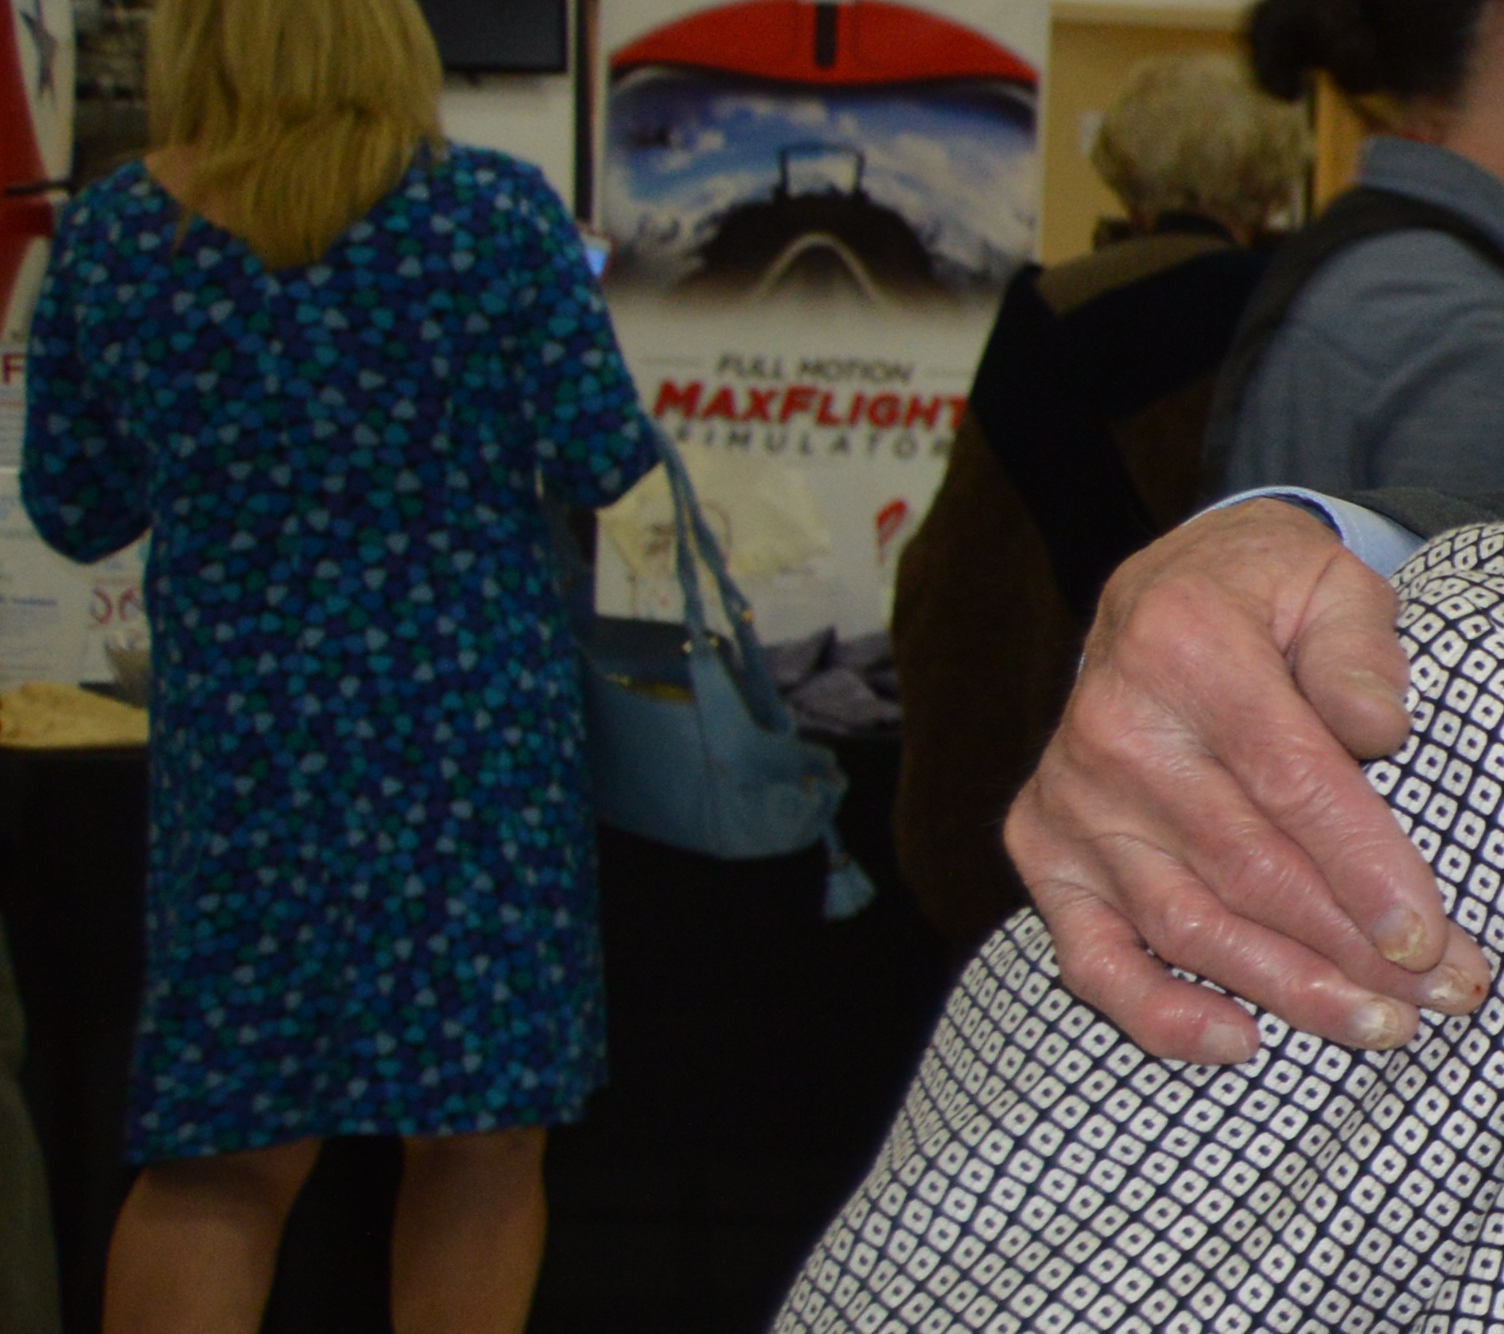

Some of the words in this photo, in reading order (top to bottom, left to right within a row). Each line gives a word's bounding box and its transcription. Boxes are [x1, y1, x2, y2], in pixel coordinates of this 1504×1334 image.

[716, 353, 784, 380] FULL
[797, 357, 913, 384] MOTION
[653, 378, 969, 430] MAXFLIGHT
